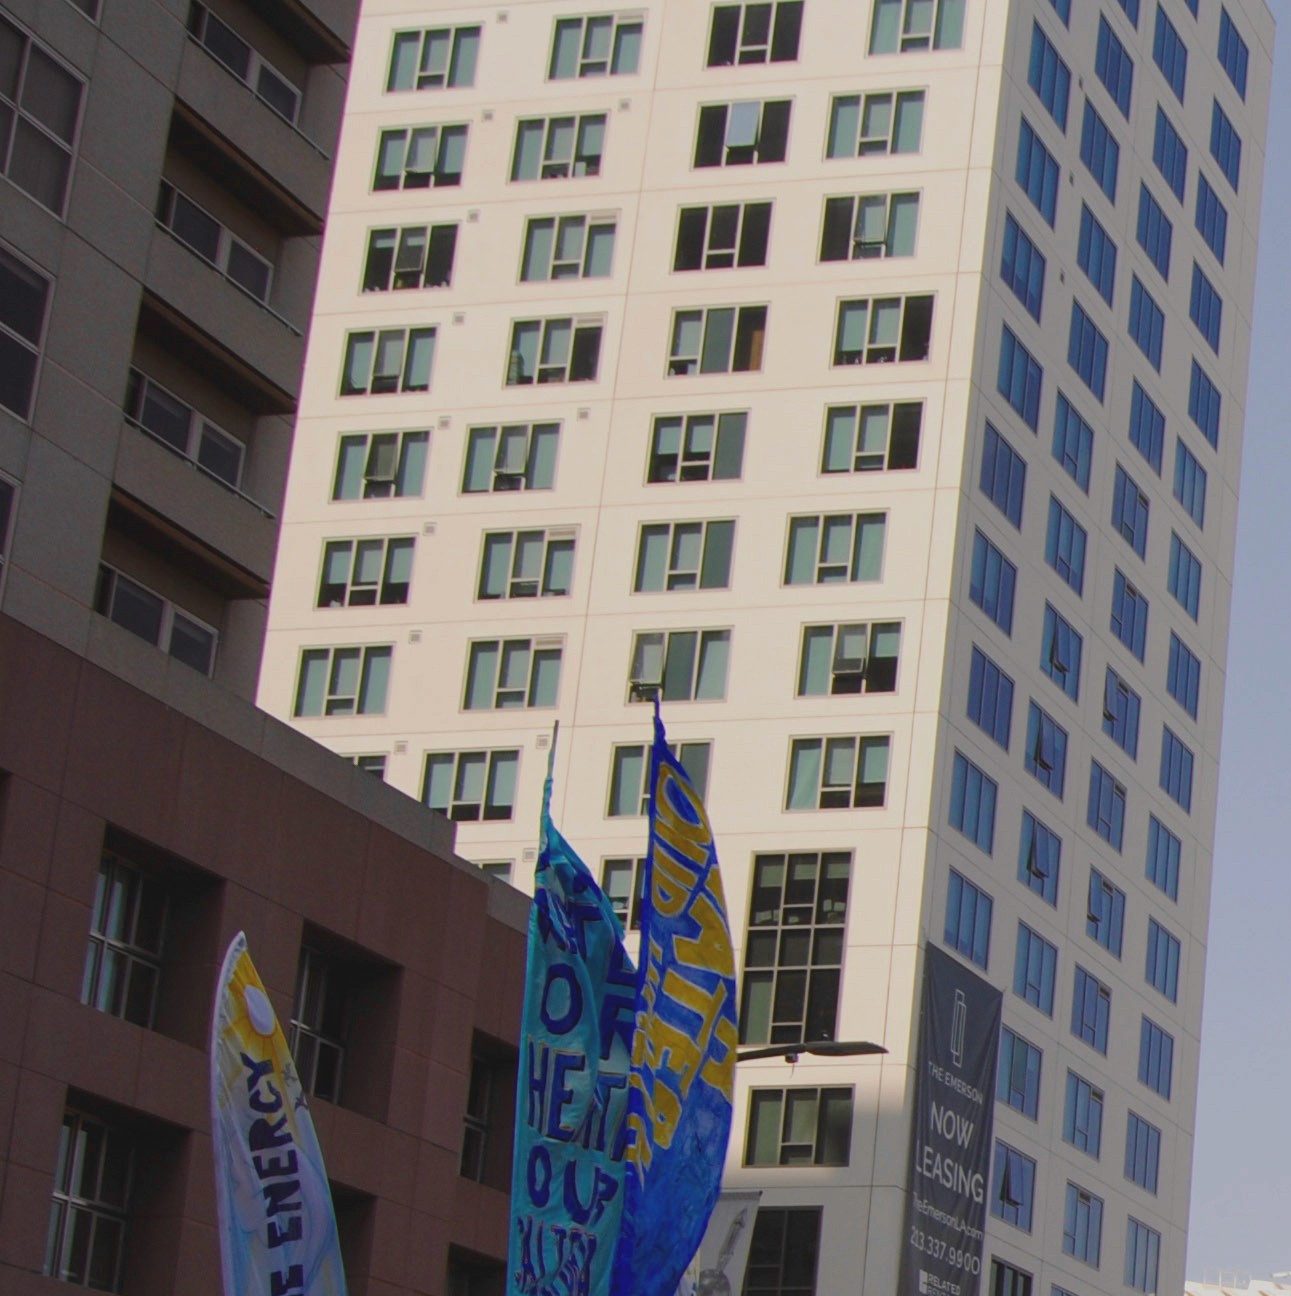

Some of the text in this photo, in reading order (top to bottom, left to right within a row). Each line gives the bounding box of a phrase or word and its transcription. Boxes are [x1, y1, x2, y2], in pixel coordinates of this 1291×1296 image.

[928, 1061, 983, 1105] THE EMERSON
[930, 1100, 974, 1149] NOW
[915, 1139, 984, 1204] LEASING
[910, 1226, 981, 1275] 213.337.9900
[929, 1273, 960, 1296] RELATED
